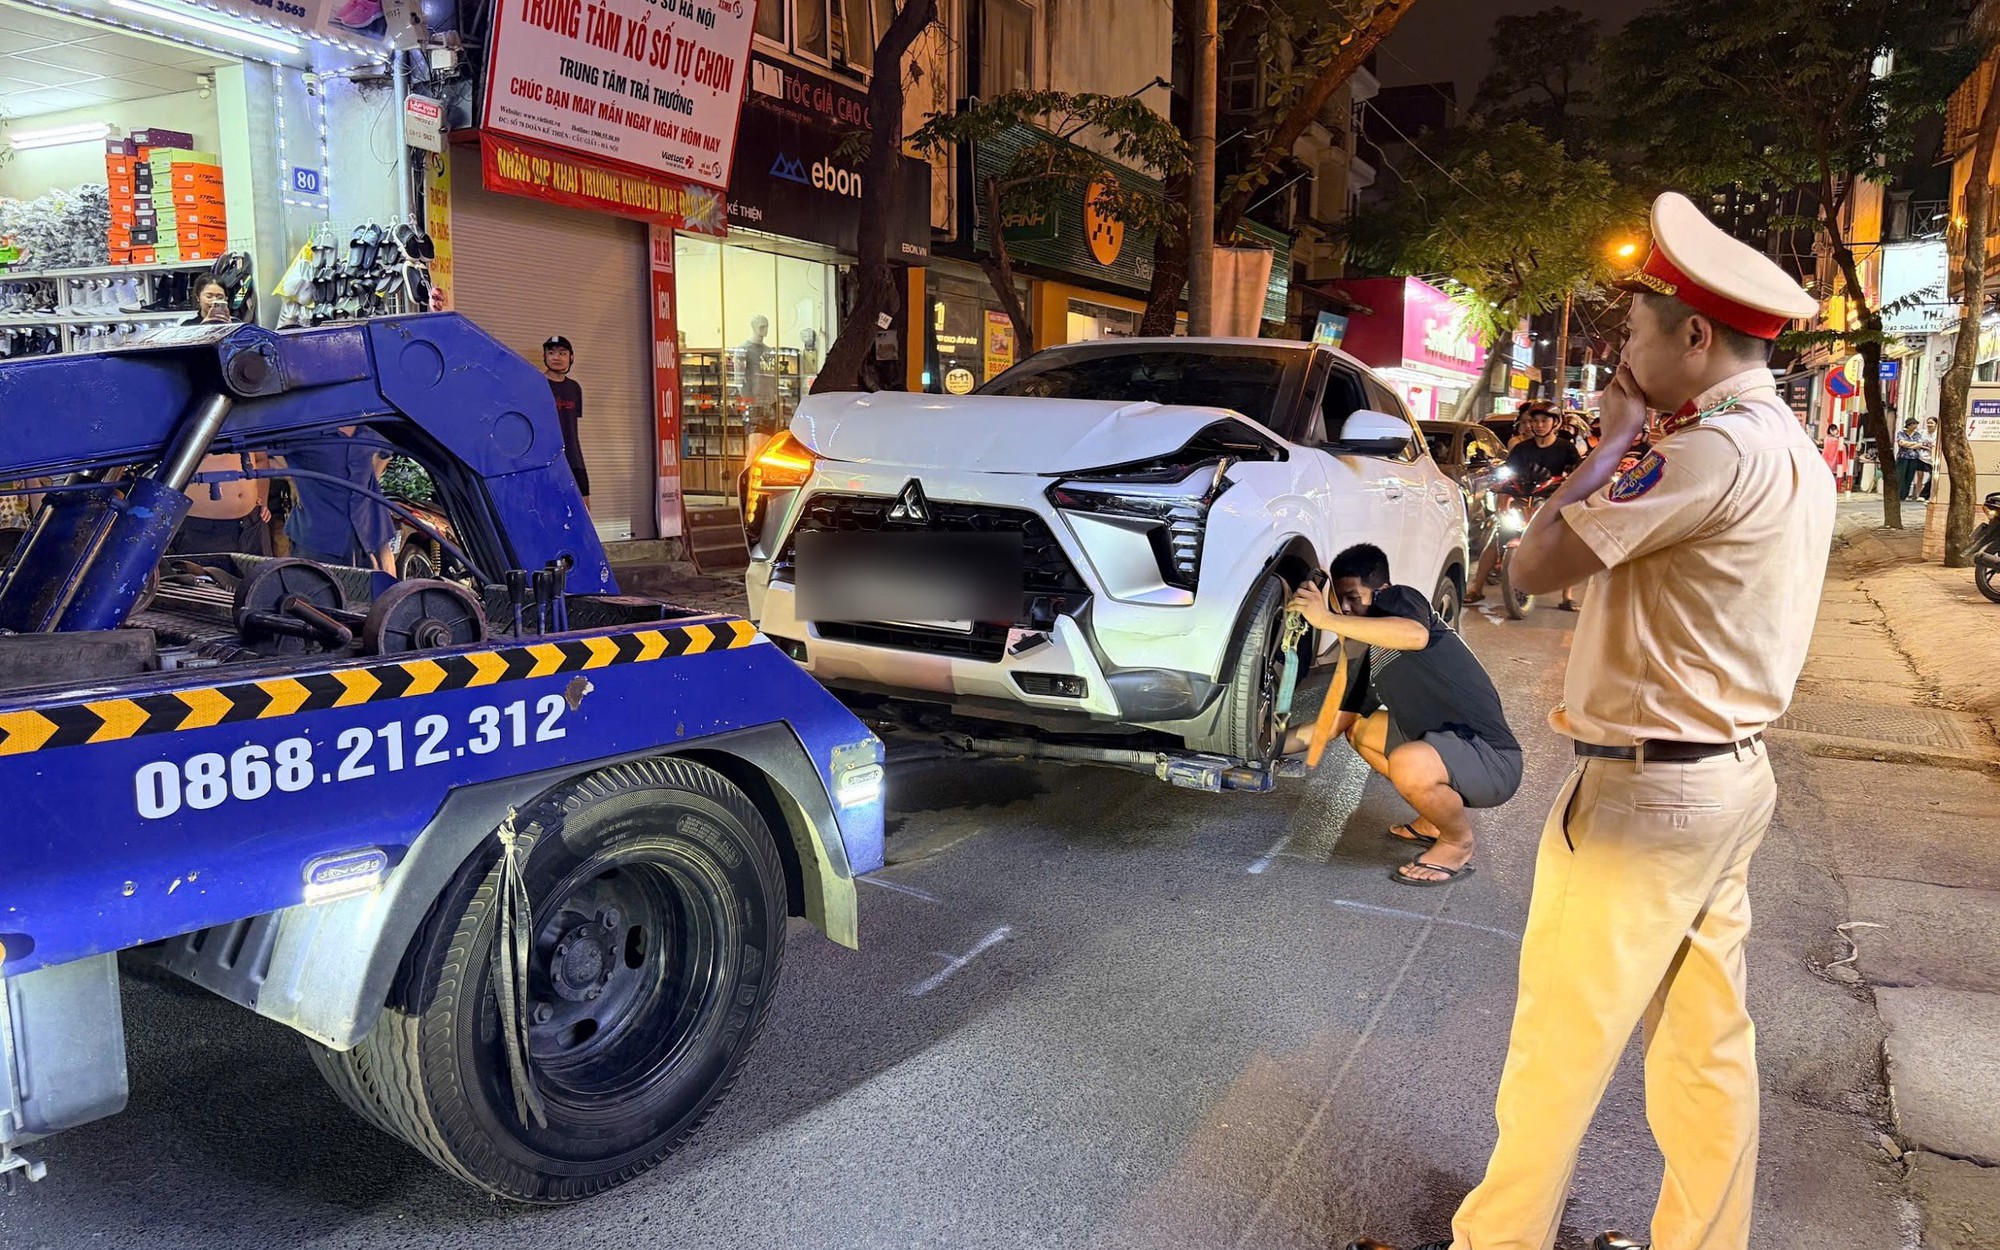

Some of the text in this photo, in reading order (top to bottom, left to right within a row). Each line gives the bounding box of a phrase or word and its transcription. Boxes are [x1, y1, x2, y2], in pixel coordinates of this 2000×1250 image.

[276, 0, 306, 18] 3663
[696, 8, 716, 30] NỘI
[521, 0, 734, 97] TRUNG TÂM XỔ SỐ TỰ CHỌN
[559, 56, 694, 115] TRUNG TÂM TRẢ THƯỞNG
[784, 72, 811, 108] TÓC
[813, 83, 835, 116] GIẢ
[838, 96, 861, 125] CAO
[510, 75, 721, 154] CHÚC BẠN MAY MẮN NGAY NGÀY HÔM NAY
[661, 150, 685, 164] Vietlott
[296, 170, 316, 190] 80
[497, 146, 531, 181] NHÂN
[531, 156, 550, 191] DỊP
[552, 162, 579, 193] KHAI
[621, 176, 658, 211] KHUYẾN
[659, 189, 679, 219] MẠI
[811, 157, 863, 199] ebon
[727, 200, 739, 216] KẾ
[739, 204, 762, 222] THIỆN
[657, 284, 671, 320] ÍCH
[656, 335, 675, 369] NƯỚC
[661, 390, 674, 424] LỢI
[662, 435, 677, 467] NHÀ
[135, 693, 567, 819] 0868.212.312
